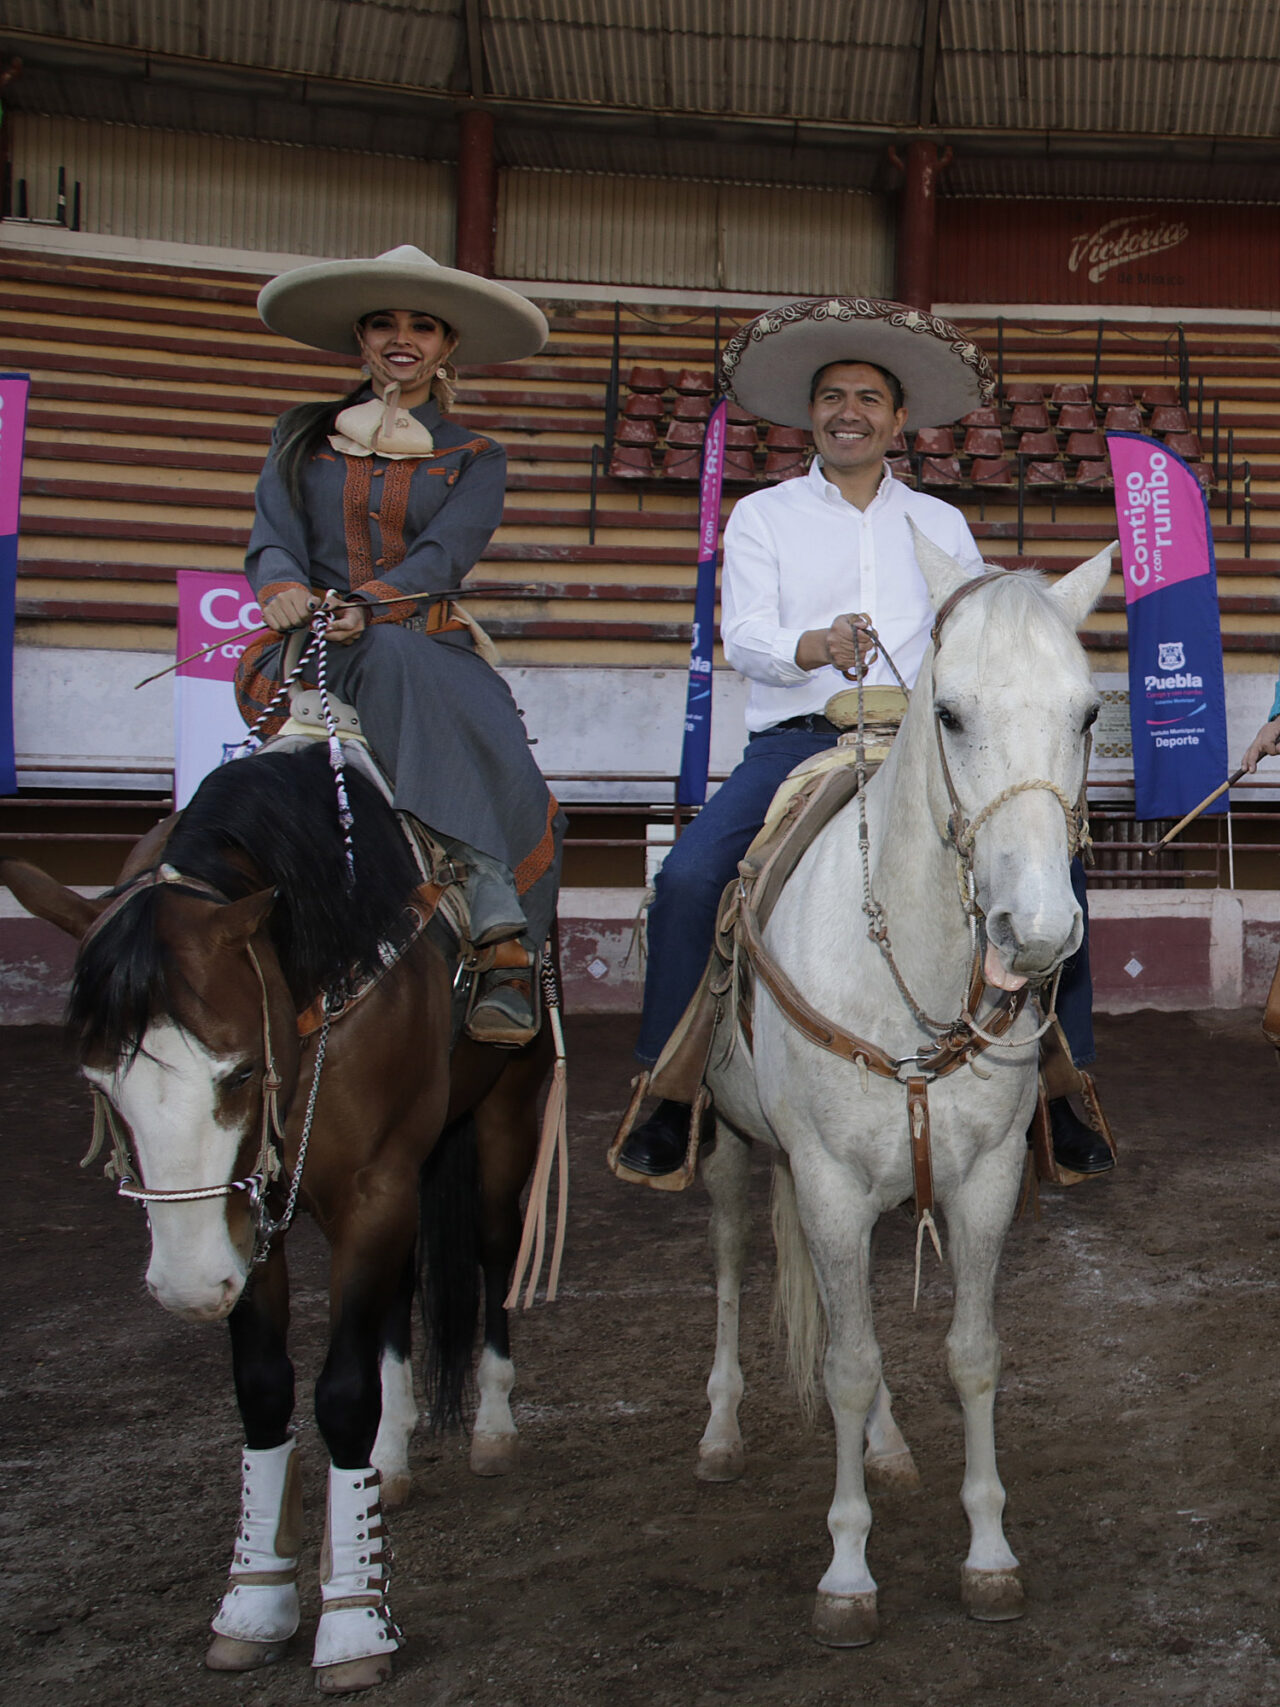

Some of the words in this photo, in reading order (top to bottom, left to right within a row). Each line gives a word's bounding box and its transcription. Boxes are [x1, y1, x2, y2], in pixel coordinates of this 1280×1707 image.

[1068, 213, 1188, 283] Victoria
[1146, 452, 1173, 547] rumbo
[1124, 471, 1151, 586] Contigo
[1154, 550, 1163, 572] con
[1154, 574, 1166, 583] y
[221, 643, 247, 659] co
[1144, 673, 1203, 691] Puebla
[1155, 735, 1200, 748] Deporte
